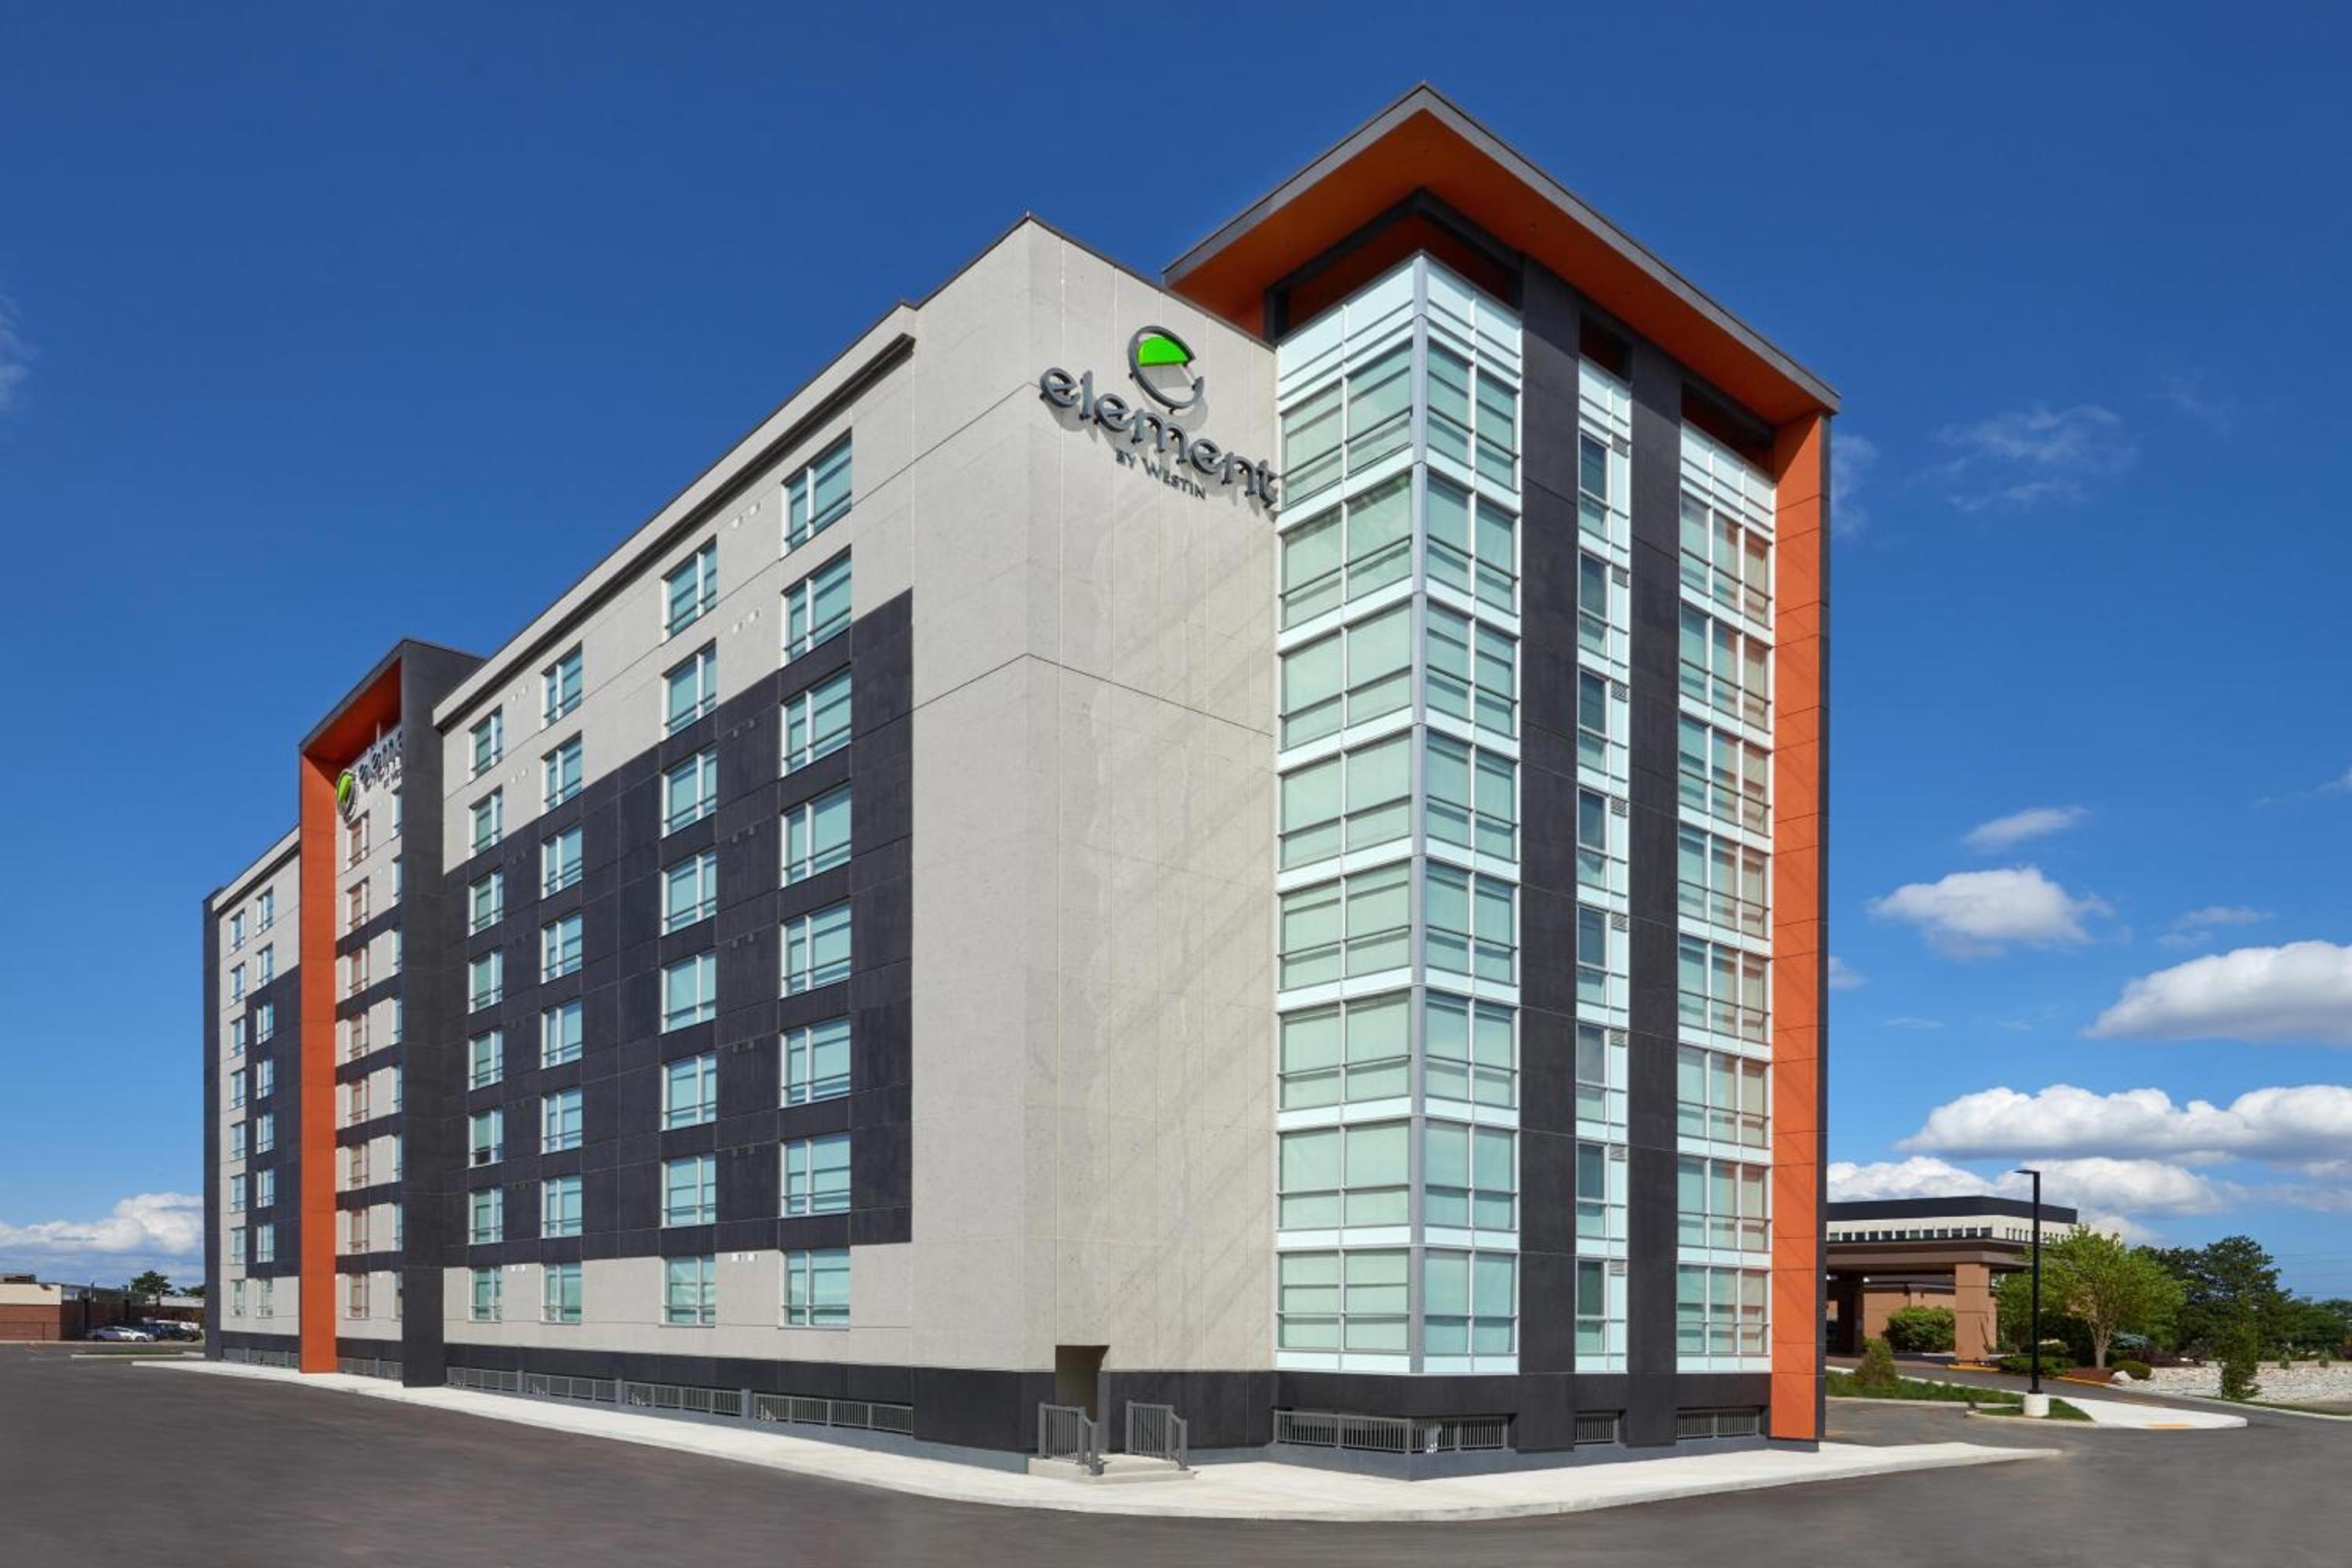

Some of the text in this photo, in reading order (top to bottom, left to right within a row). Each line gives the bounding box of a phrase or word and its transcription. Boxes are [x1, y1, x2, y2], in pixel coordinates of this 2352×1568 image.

[1040, 368, 1279, 505] element
[1116, 448, 1206, 500] BY WESTIN
